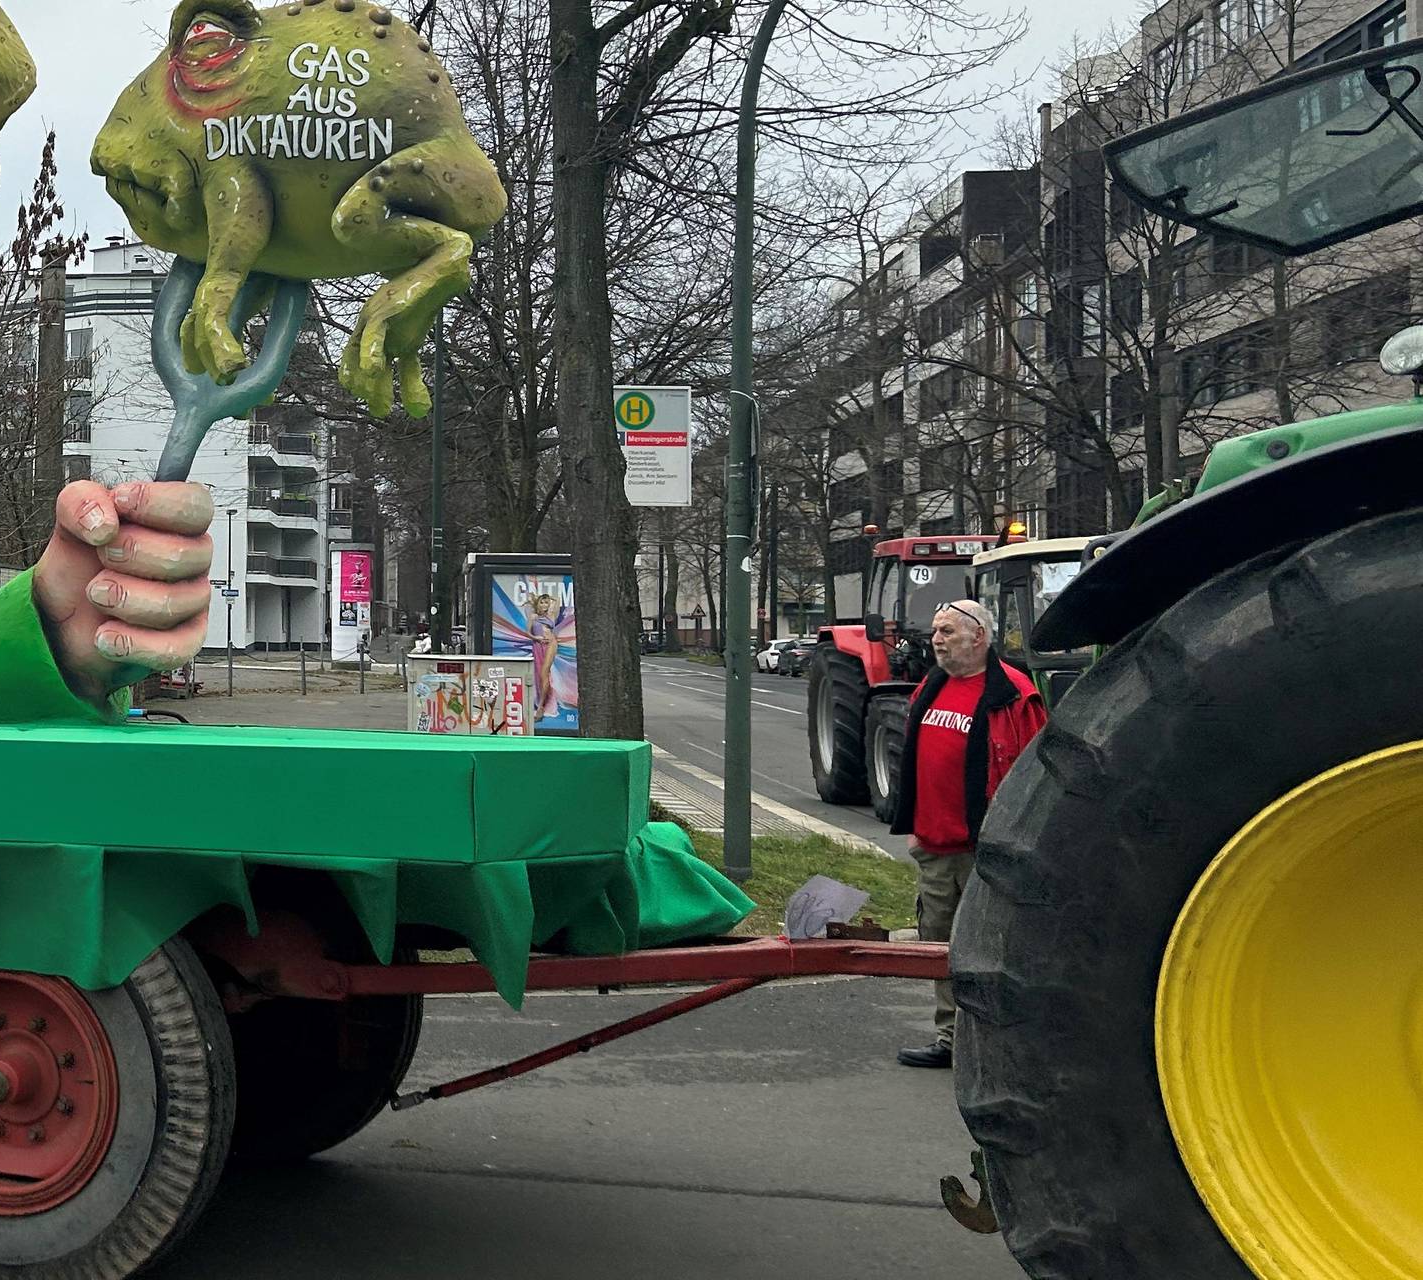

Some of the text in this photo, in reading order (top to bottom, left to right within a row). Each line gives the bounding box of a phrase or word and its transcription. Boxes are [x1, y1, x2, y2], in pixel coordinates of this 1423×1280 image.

[287, 42, 371, 86] GAS
[286, 83, 358, 118] AUS
[203, 113, 394, 162] DIKTATUREN
[626, 399, 643, 422] H
[913, 568, 930, 581] 79
[513, 581, 575, 607] GNTM
[921, 708, 973, 734] LEITUNG
